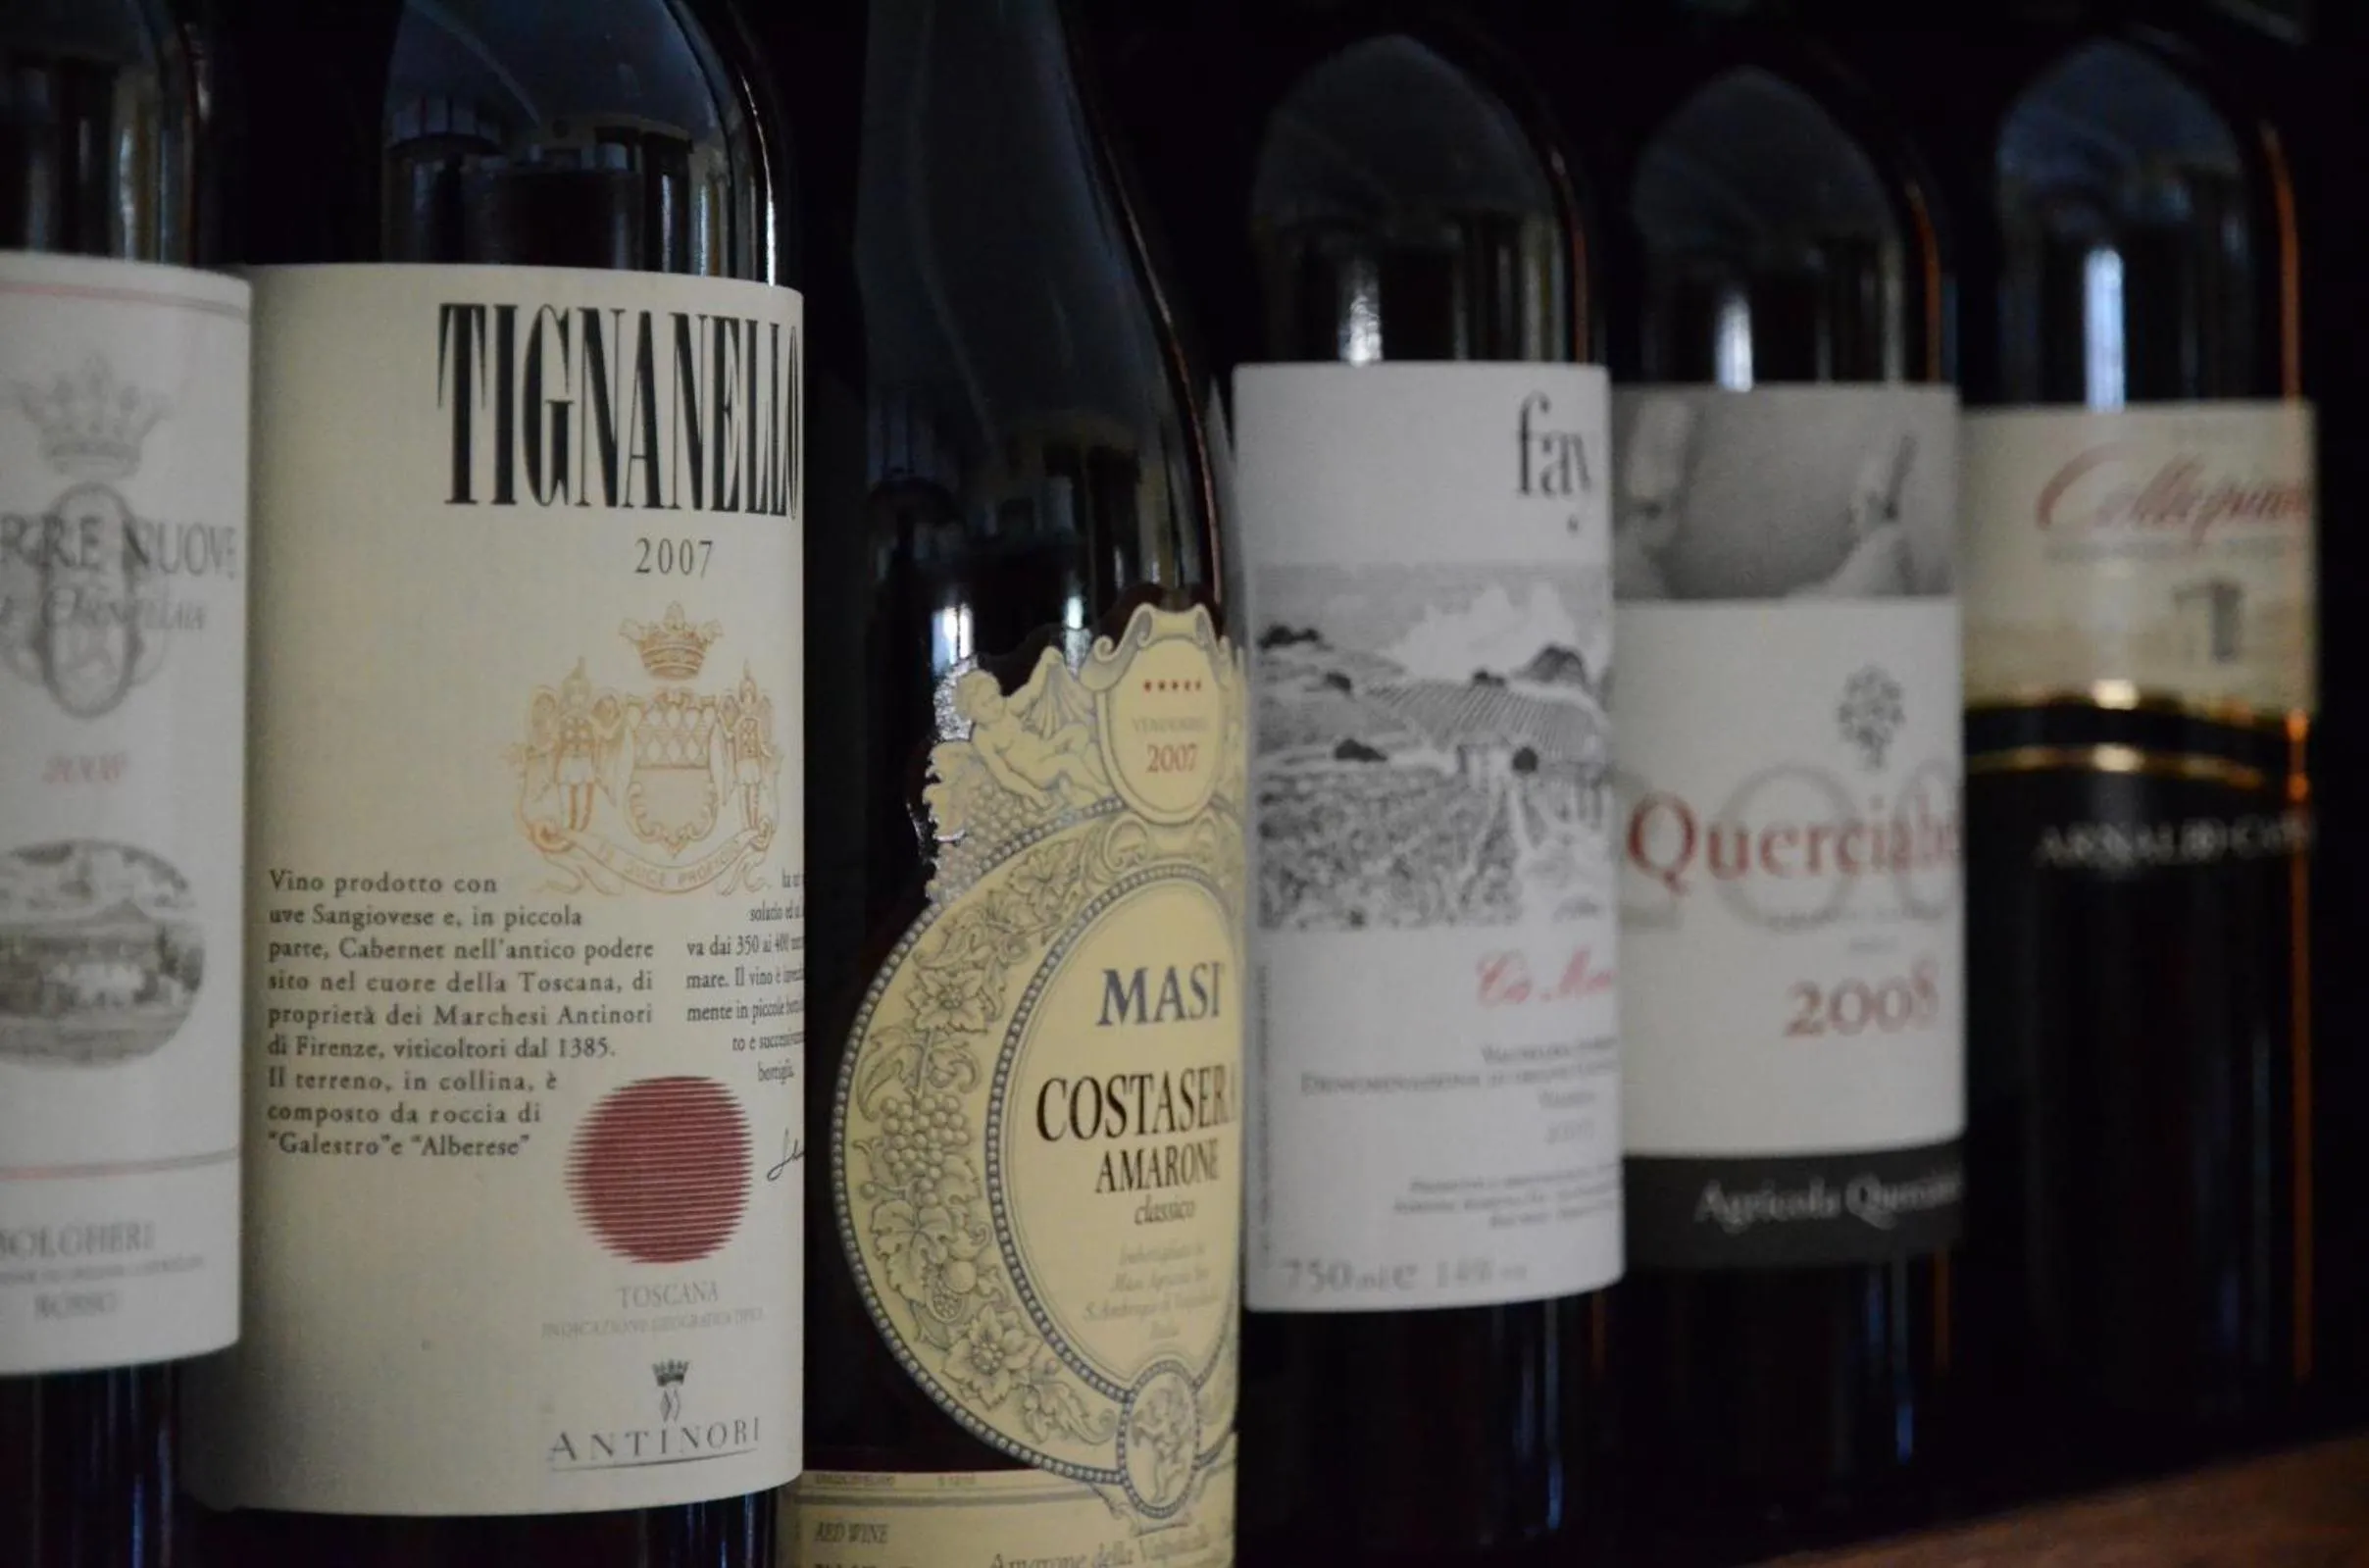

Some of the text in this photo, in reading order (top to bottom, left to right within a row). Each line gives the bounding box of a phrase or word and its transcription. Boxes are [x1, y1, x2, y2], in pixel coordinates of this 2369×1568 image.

[436, 302, 800, 522] TIGNANELLO
[634, 536, 715, 579] 2007
[1145, 742, 1199, 773] 2007
[270, 870, 497, 897] Vino prodotto con
[269, 903, 581, 932] uve Sangiovese e, in piccola
[268, 940, 328, 962] parte,
[338, 937, 445, 959] Cabernet
[584, 936, 653, 965] podere
[686, 941, 704, 956] va
[709, 935, 731, 956] dai
[735, 935, 759, 956] 350
[268, 969, 653, 993] sito nel cuore della Toscana, di
[685, 974, 730, 988] mare.
[748, 966, 773, 986] vino
[1095, 961, 1223, 1027] MASI
[1782, 954, 1941, 1038] 2008
[268, 1003, 653, 1029] proprietà dei Marchesi Antinori
[686, 1006, 733, 1022] mente
[735, 998, 748, 1019] in
[267, 1034, 616, 1059] di Firenze, viticoltori dal 1385.
[732, 1037, 745, 1052] to
[268, 1066, 557, 1092] Il terreno, in collina, è
[268, 1101, 540, 1128] composto da roccia di
[1095, 1138, 1219, 1193] AMARONE
[616, 1281, 719, 1310] TOSCANA
[547, 1416, 760, 1463] ANTINORI
[847, 1522, 889, 1544] WINE
